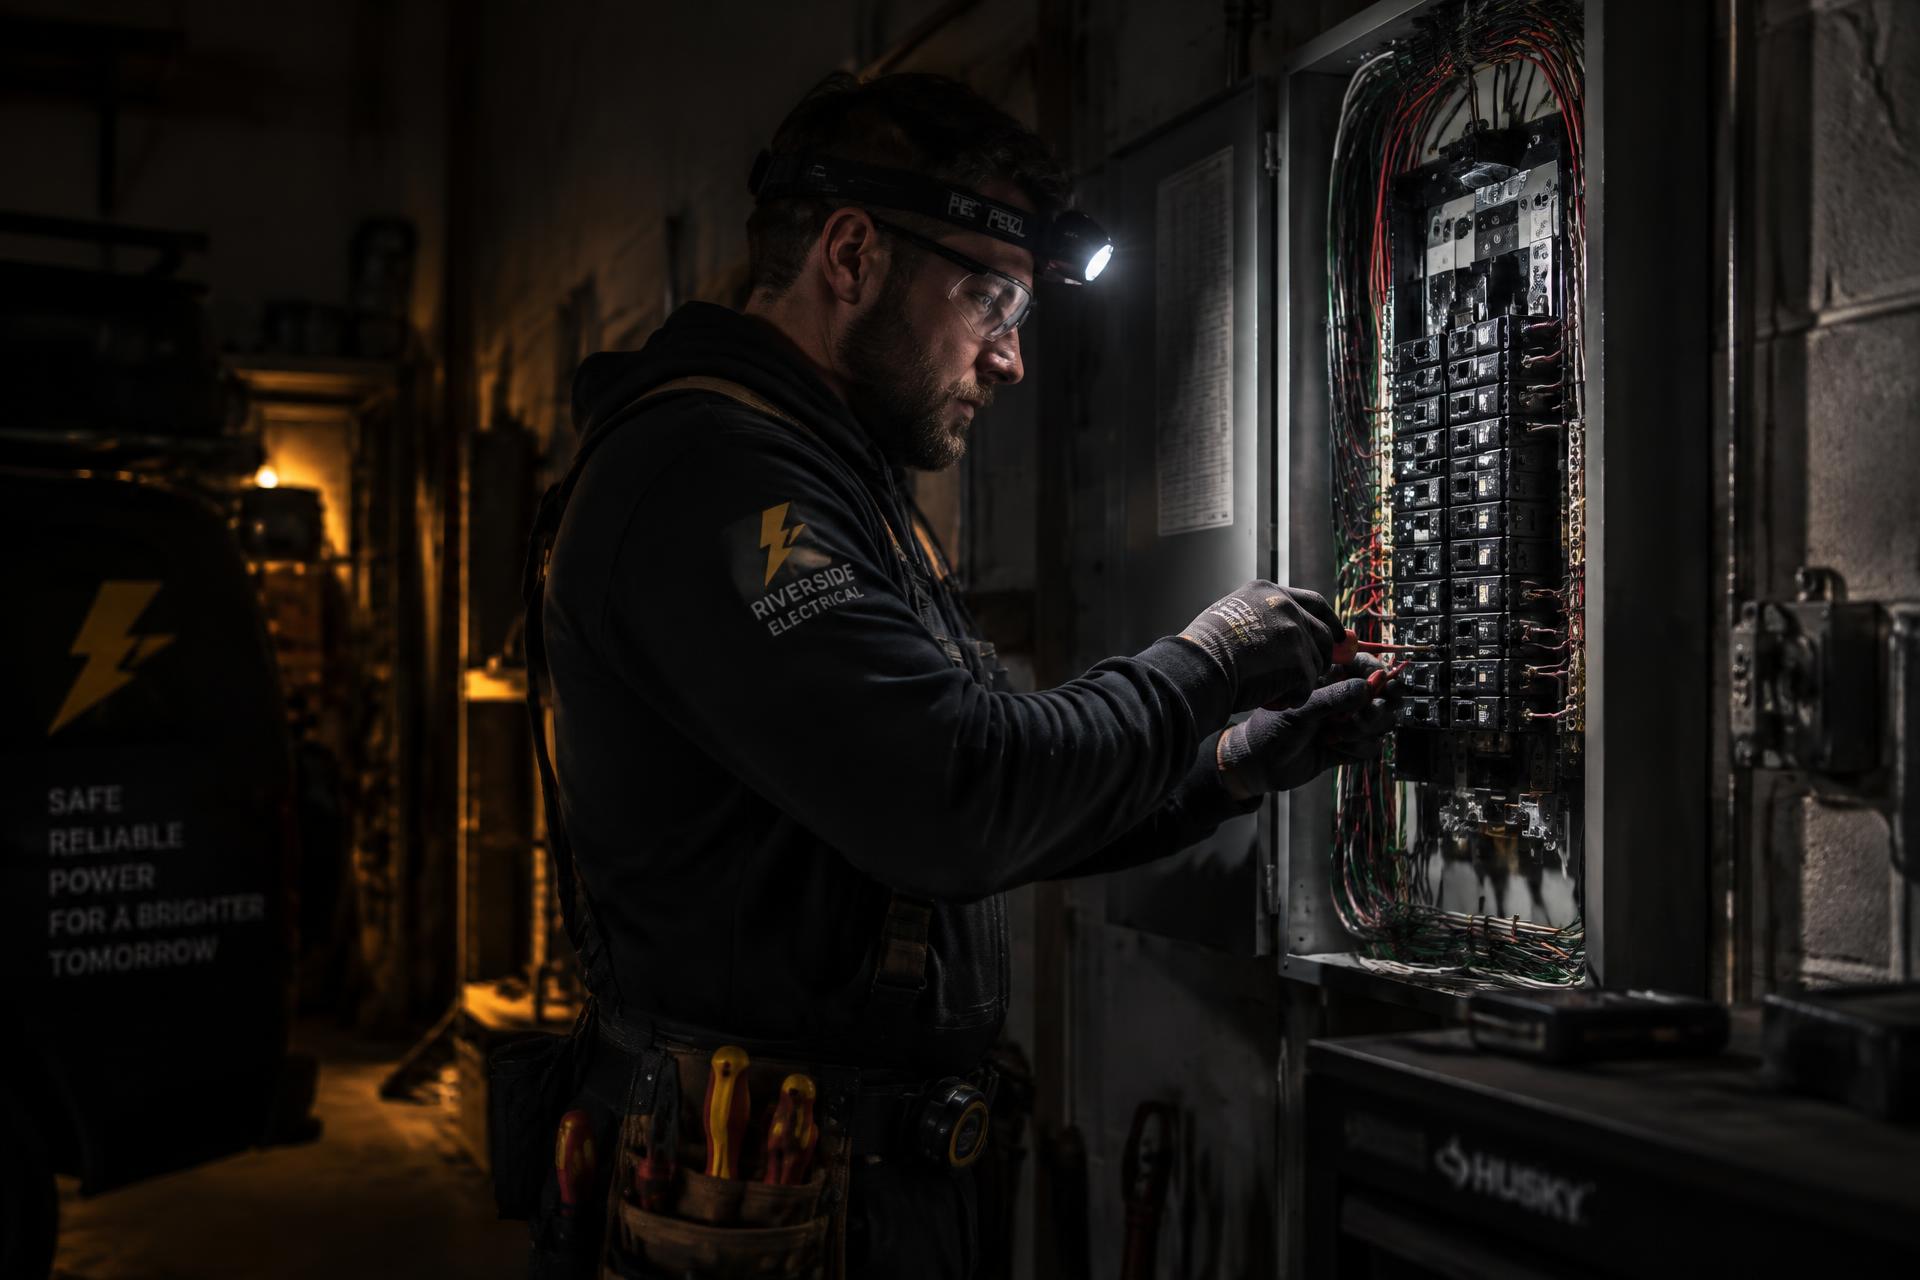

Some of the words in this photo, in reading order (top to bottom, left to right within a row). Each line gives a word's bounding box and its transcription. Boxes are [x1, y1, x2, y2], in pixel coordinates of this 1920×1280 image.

[750, 563, 855, 620] RIVERSIDE
[768, 586, 864, 636] ELECTRICAL
[49, 784, 124, 816] SAFE
[49, 821, 184, 856] RELIABLE
[49, 862, 155, 898] POWER
[49, 905, 107, 938] FOR
[112, 903, 132, 934] A
[136, 892, 265, 929] BRIGHTER
[49, 931, 220, 978] TOMORROW
[1472, 1151, 1596, 1226] HUSKY
